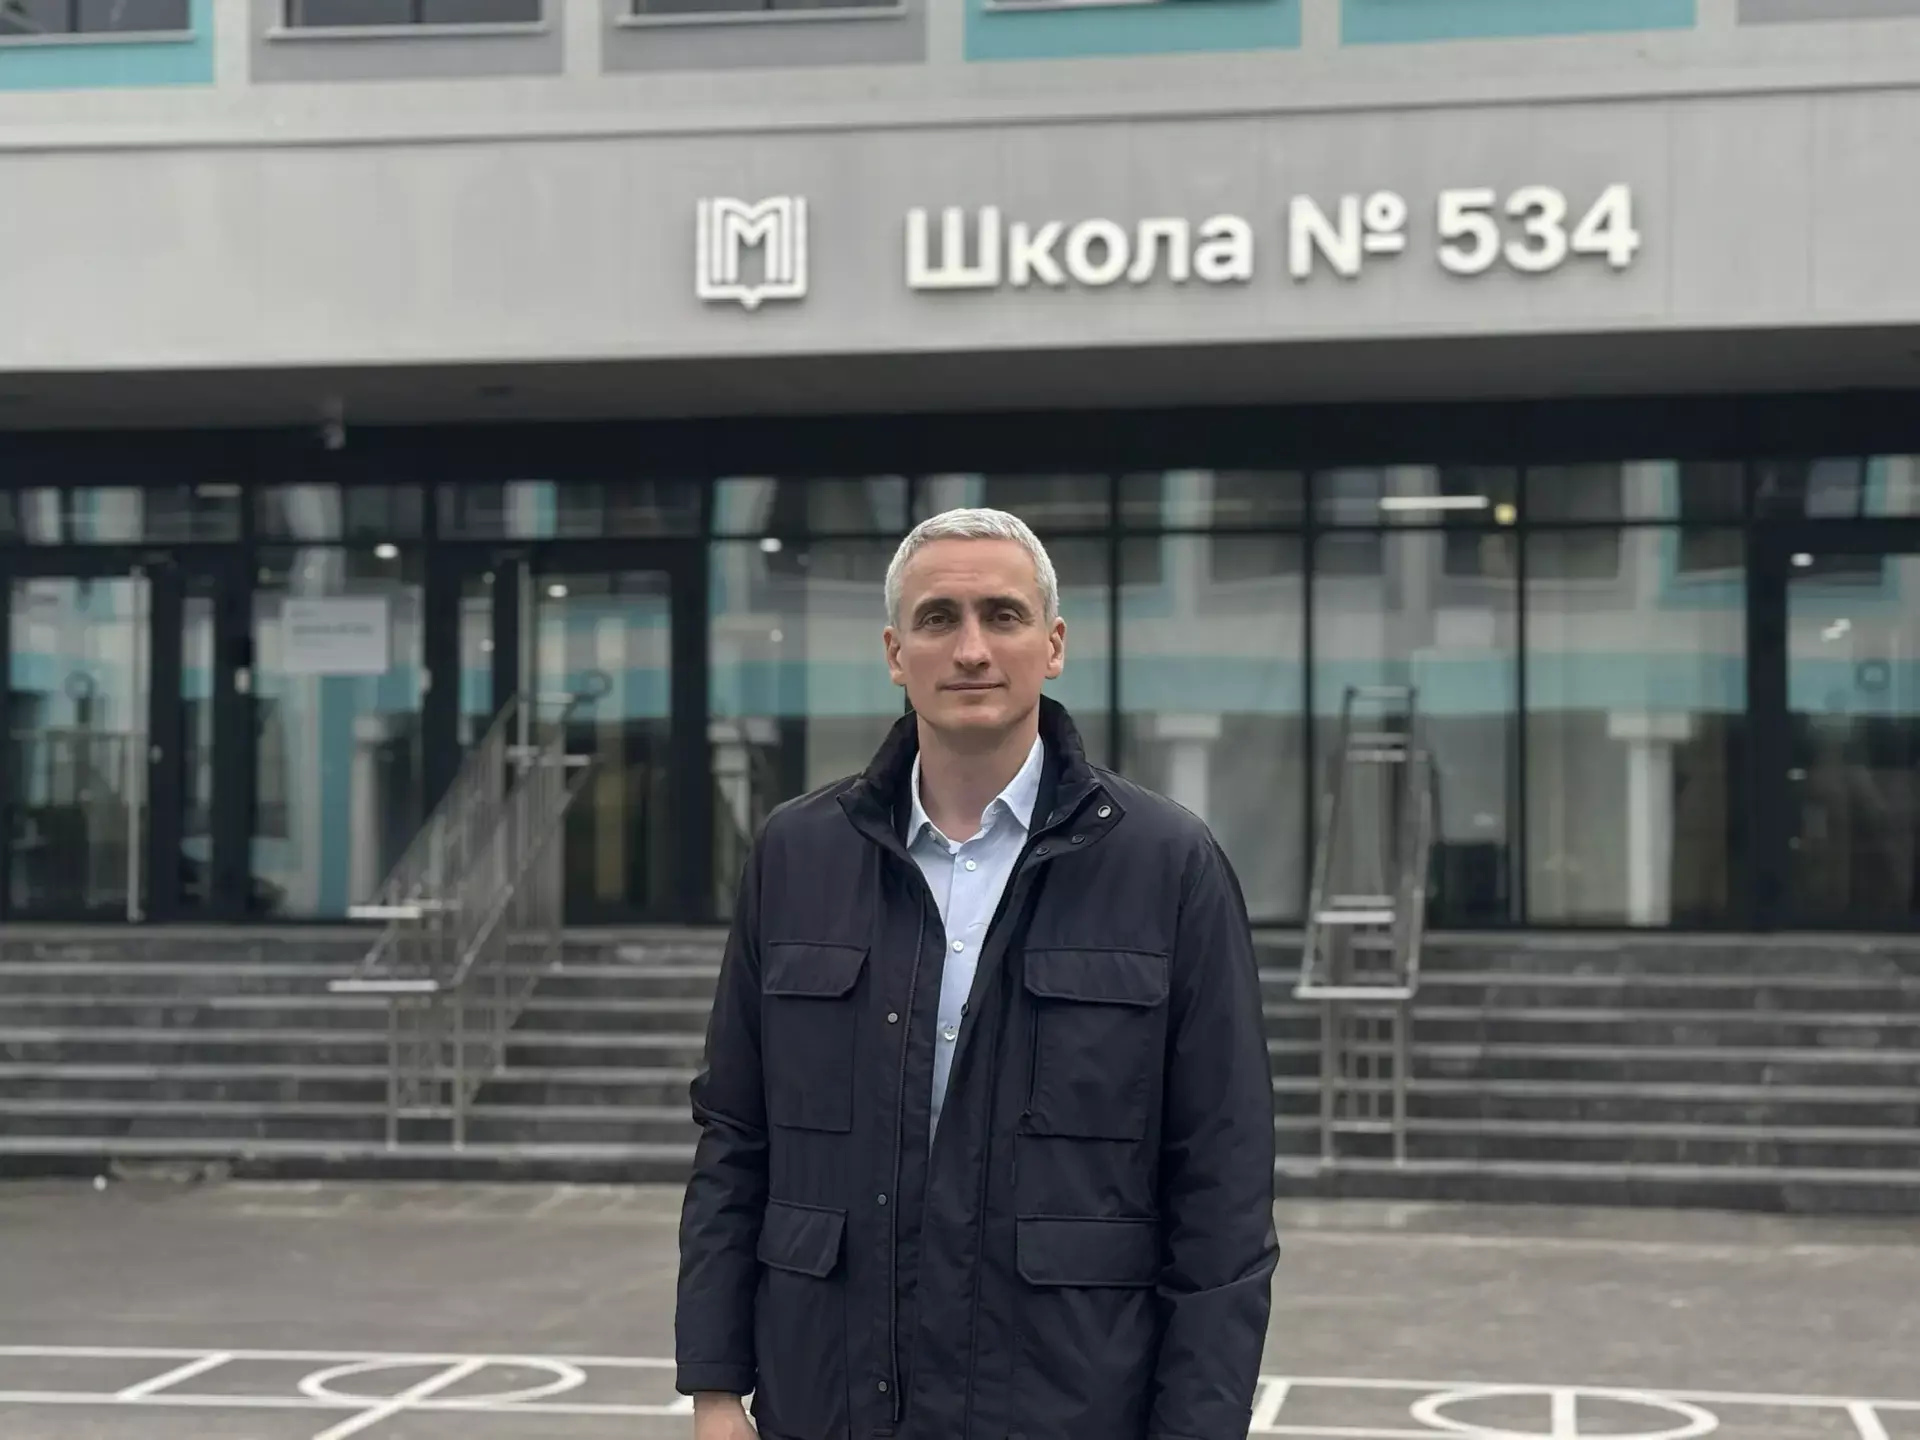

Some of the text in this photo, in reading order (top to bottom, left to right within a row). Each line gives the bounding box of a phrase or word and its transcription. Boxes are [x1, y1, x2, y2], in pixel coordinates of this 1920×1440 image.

[907, 185, 1640, 288] Школа № 534
